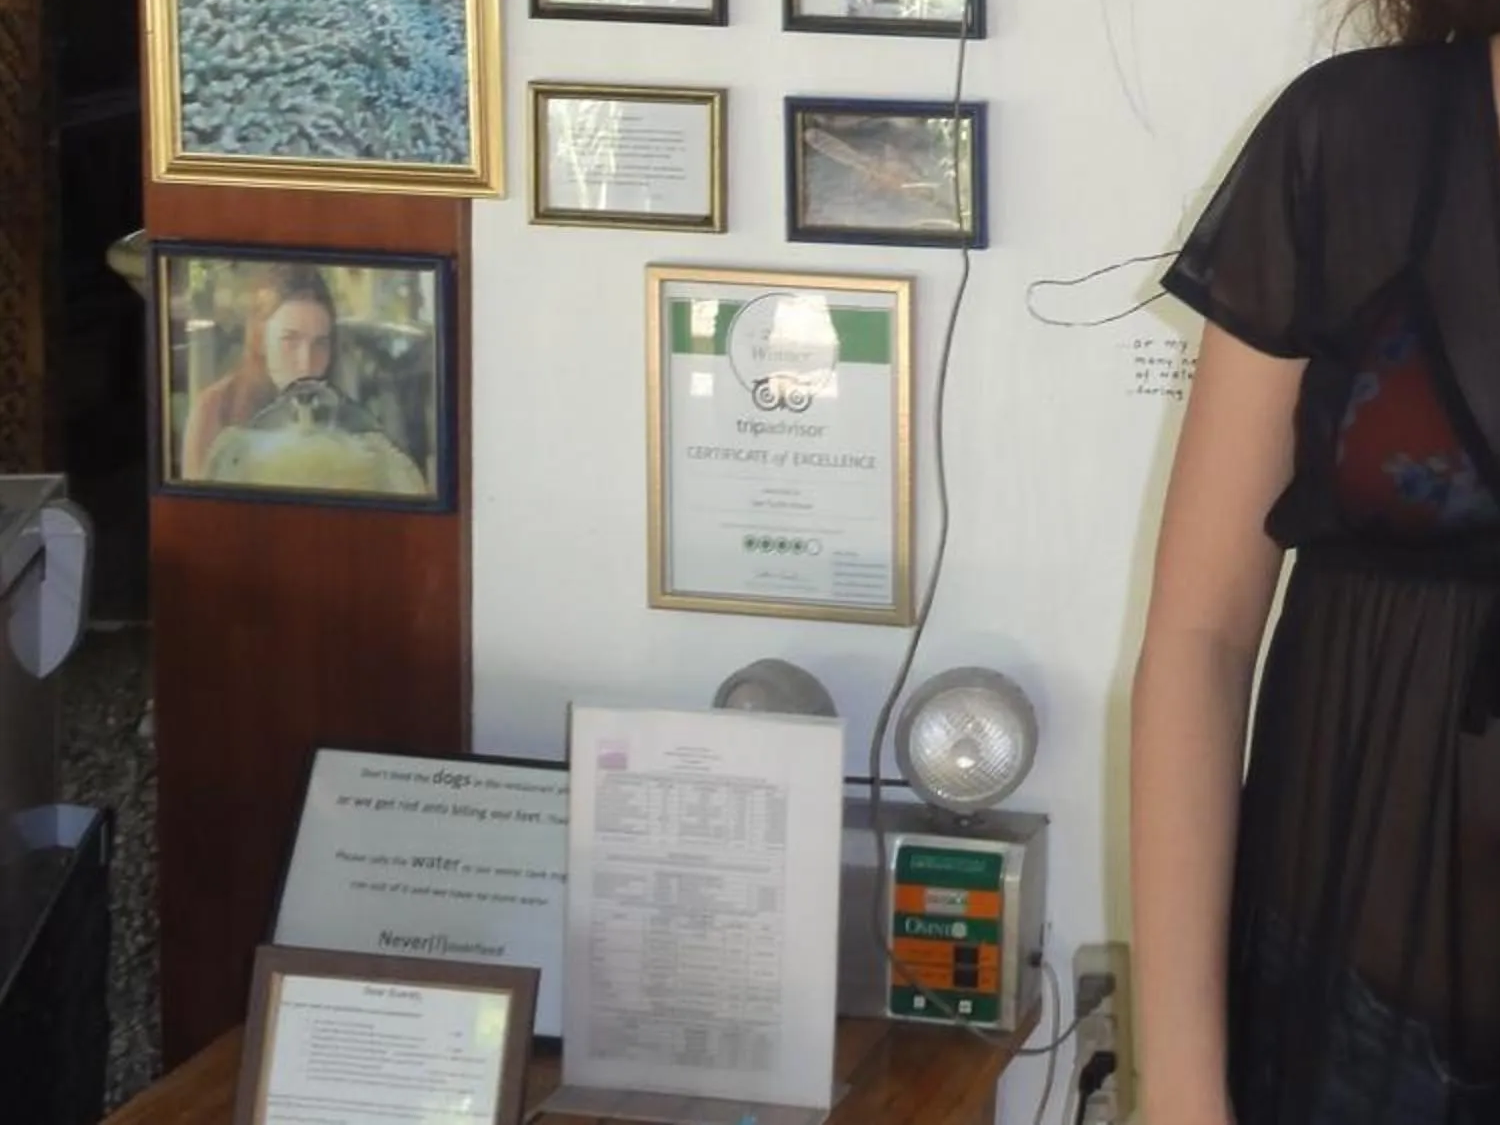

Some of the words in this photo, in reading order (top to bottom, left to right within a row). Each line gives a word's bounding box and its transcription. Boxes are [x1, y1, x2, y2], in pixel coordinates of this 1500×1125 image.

[736, 418, 828, 440] tripadvisor
[687, 445, 769, 465] CERTIFICATE
[793, 451, 878, 470] EXCELLENCE
[433, 768, 471, 789] dogs
[411, 854, 461, 872] water
